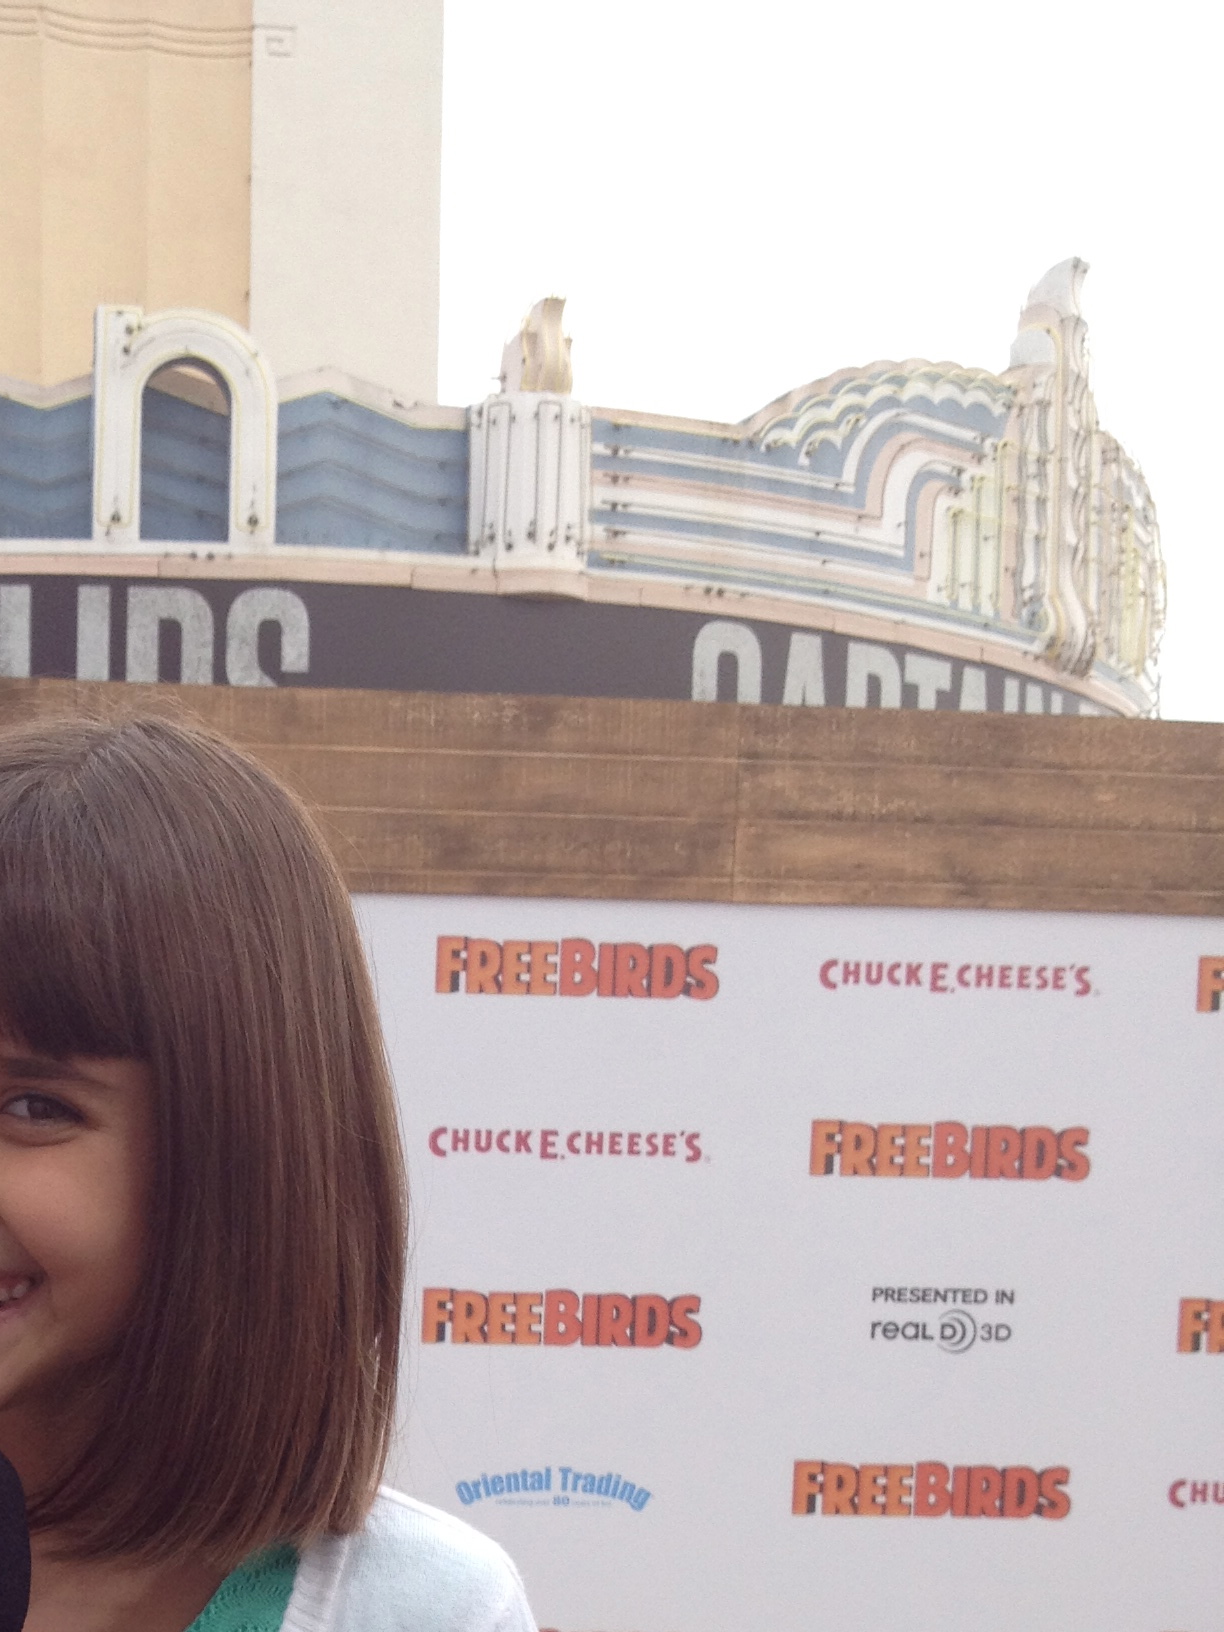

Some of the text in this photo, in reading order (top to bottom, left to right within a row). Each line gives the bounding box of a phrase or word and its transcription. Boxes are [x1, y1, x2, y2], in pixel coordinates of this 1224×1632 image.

[819, 958, 923, 990] CHUCK
[954, 963, 1092, 997] CHEESE'S
[428, 1126, 533, 1158] CHUCK
[566, 1130, 702, 1164] CHEESE'S
[872, 1286, 1015, 1305] PRESENTED IN
[455, 1466, 653, 1512] Oriental Trading
